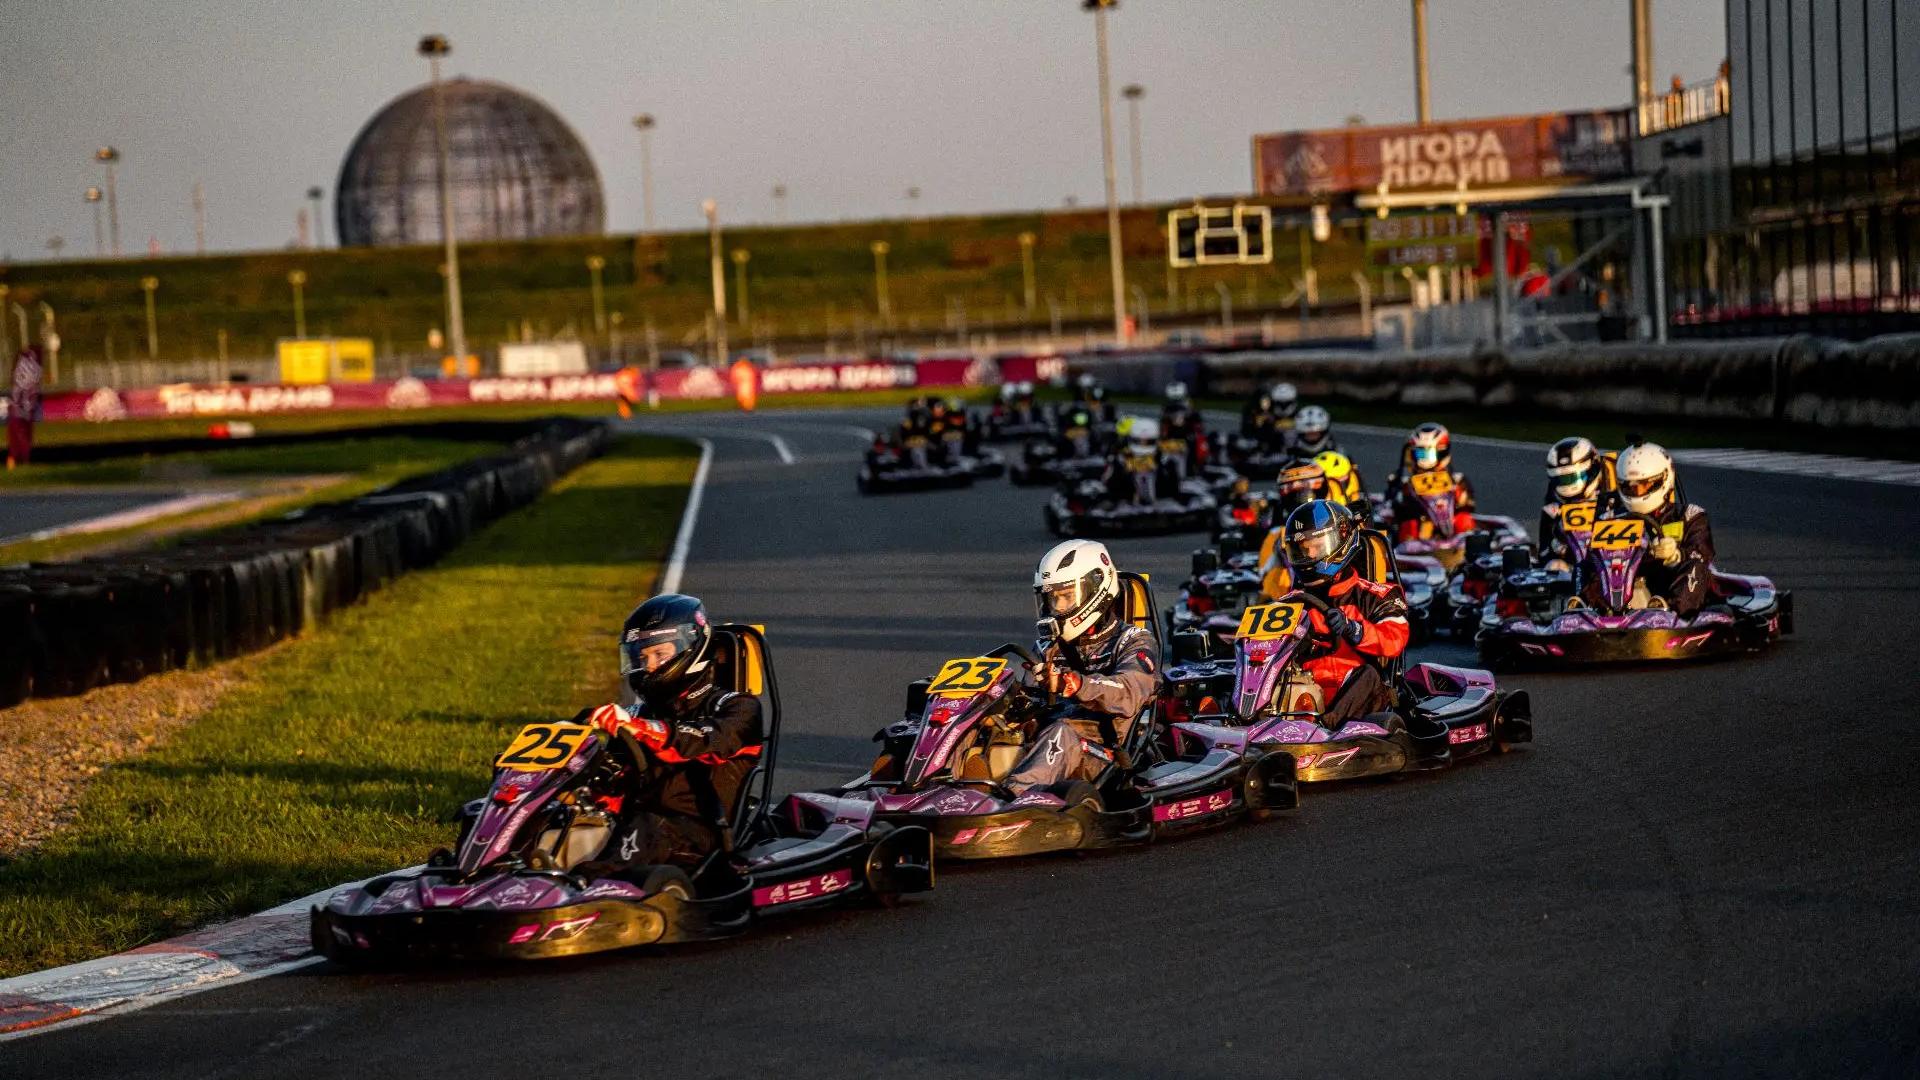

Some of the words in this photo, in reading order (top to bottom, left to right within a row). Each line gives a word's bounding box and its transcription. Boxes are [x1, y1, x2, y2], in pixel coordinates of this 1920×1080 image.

[1380, 130, 1504, 163] ИГОРА
[1593, 523, 1640, 545] 44
[1247, 606, 1295, 635] 18
[933, 661, 1001, 689] 23
[501, 727, 584, 765] 25
